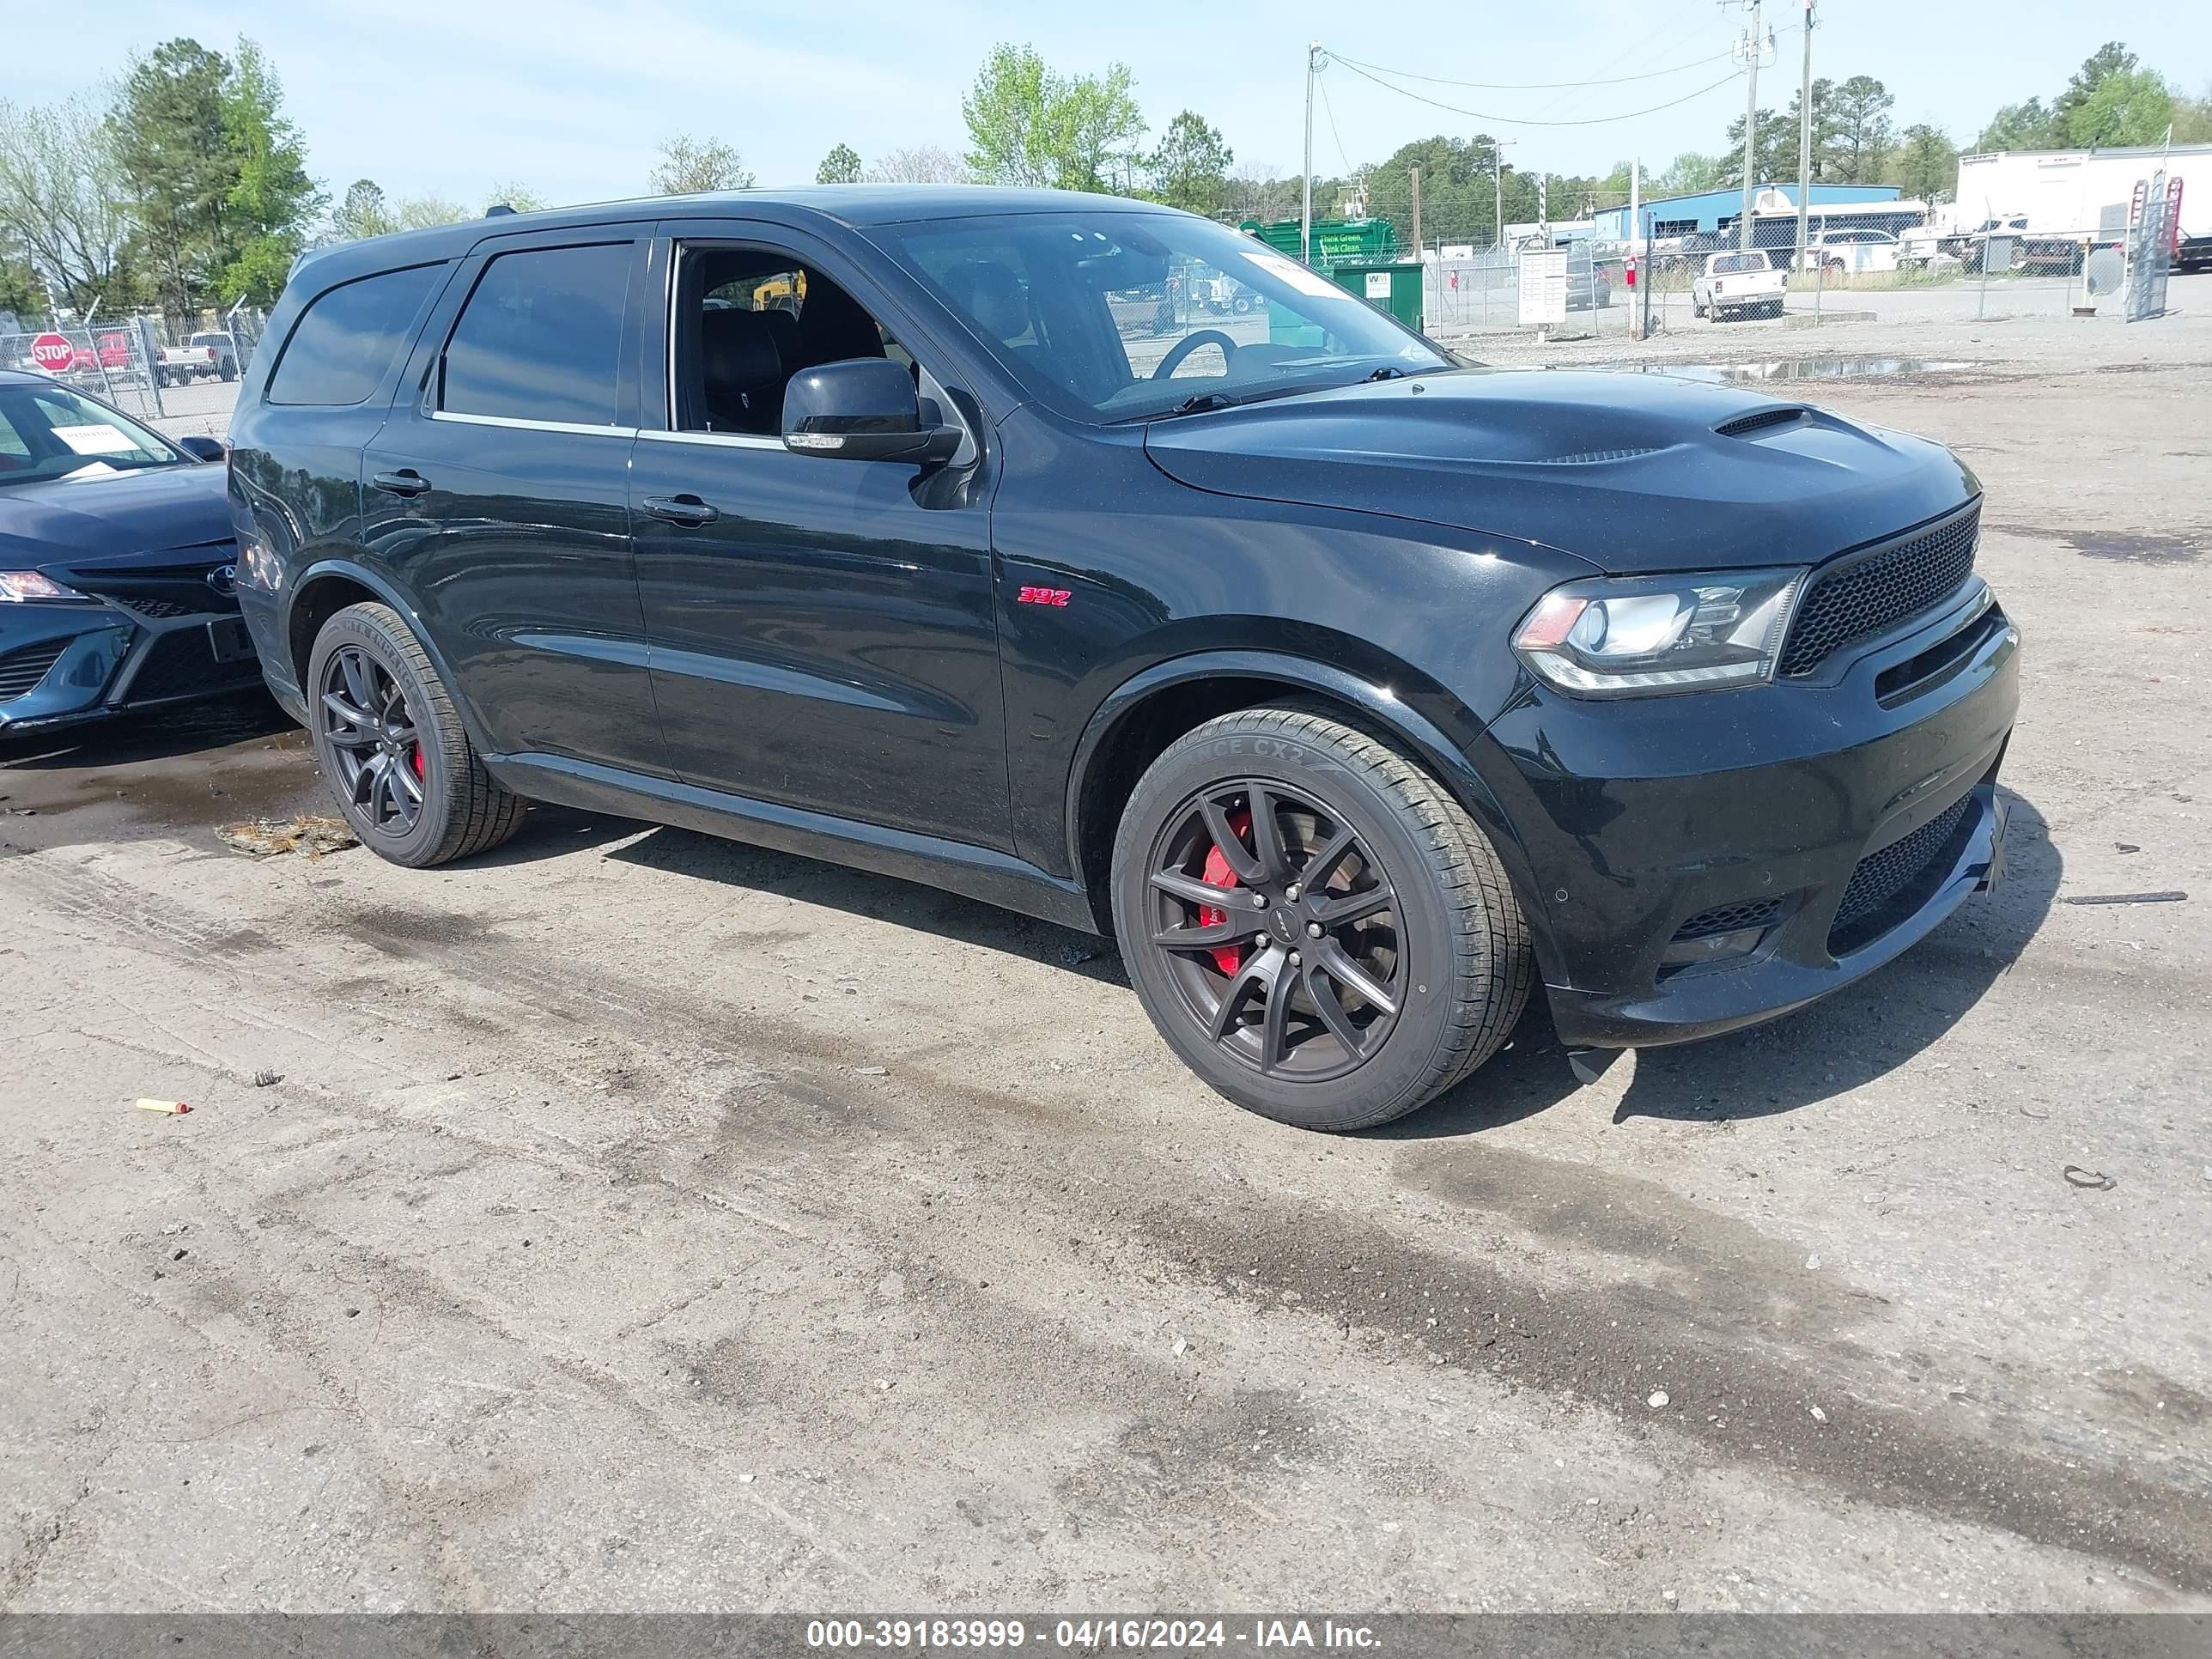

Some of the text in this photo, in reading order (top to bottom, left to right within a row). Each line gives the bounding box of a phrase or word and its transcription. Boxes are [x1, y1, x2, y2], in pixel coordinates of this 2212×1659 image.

[1340, 234, 1363, 242] Green,
[1322, 244, 1340, 254] hink
[34, 344, 70, 361] STOP
[1017, 586, 1071, 606] 392
[1253, 738, 1304, 765] CX2
